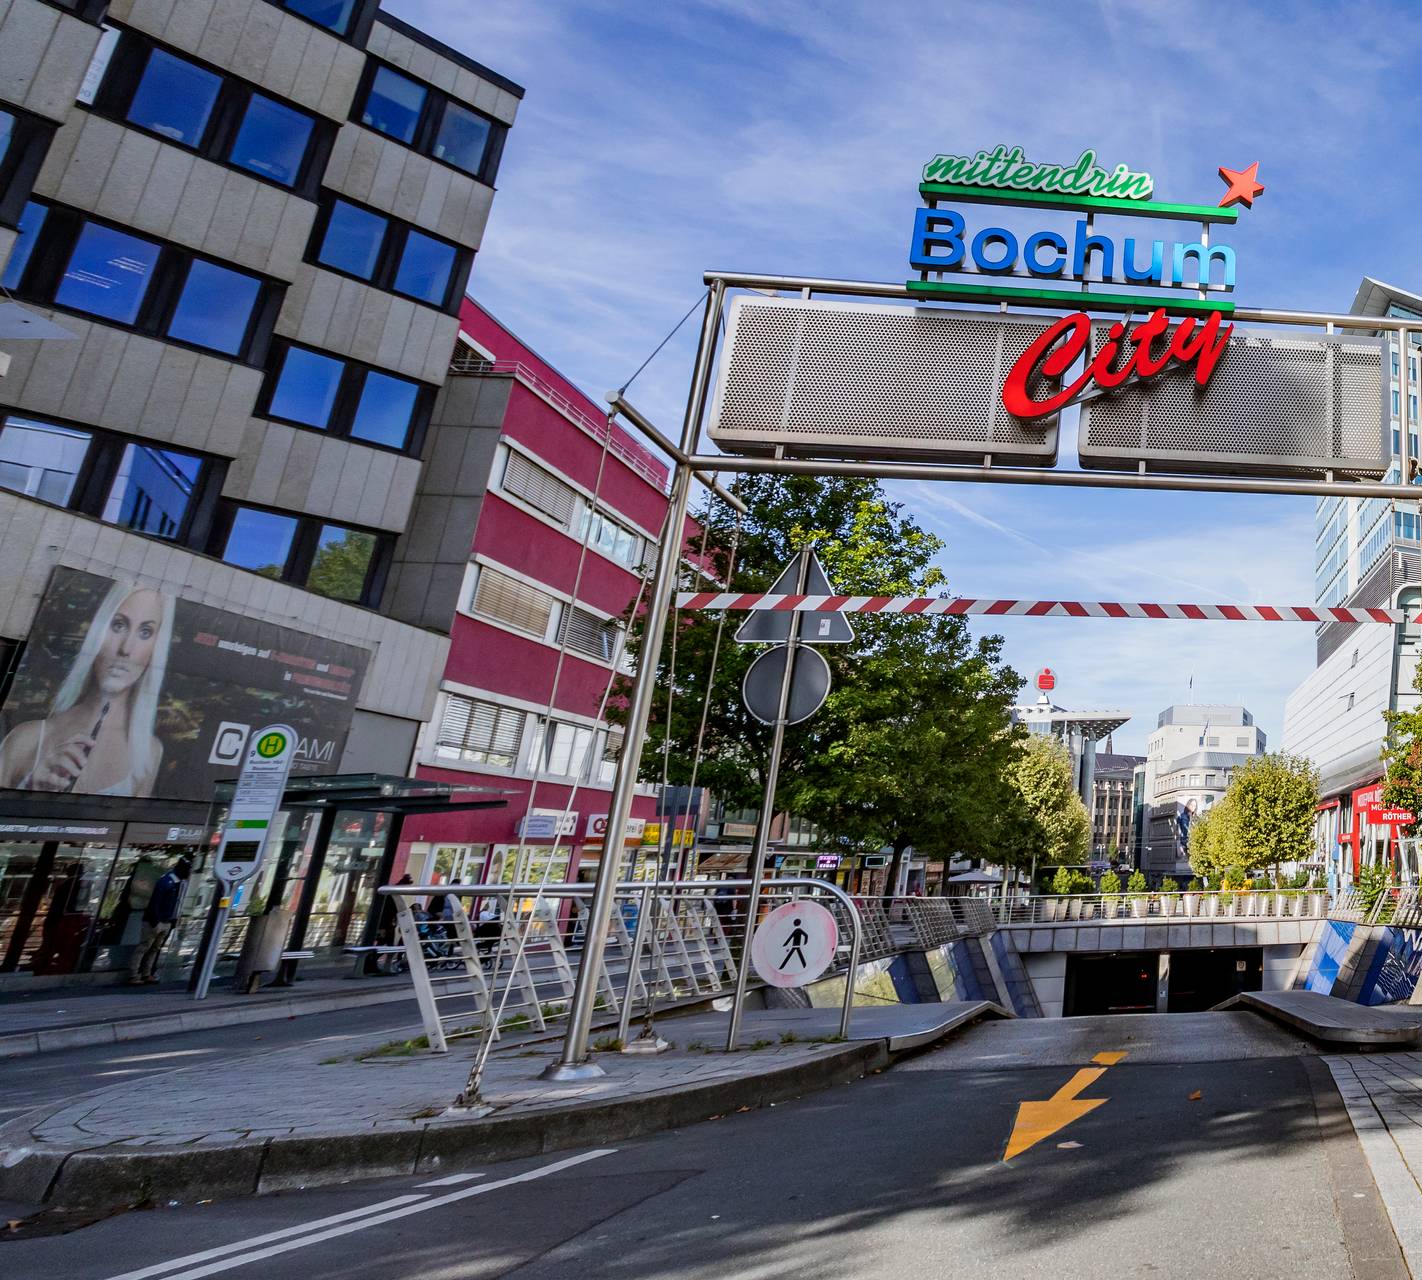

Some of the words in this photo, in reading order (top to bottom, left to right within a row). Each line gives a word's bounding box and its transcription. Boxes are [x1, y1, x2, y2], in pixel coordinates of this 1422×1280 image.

[922, 145, 1153, 200] mittendrin
[910, 208, 1236, 292] Bochum
[1002, 308, 1234, 418] City
[1382, 811, 1412, 821] RÖTHER
